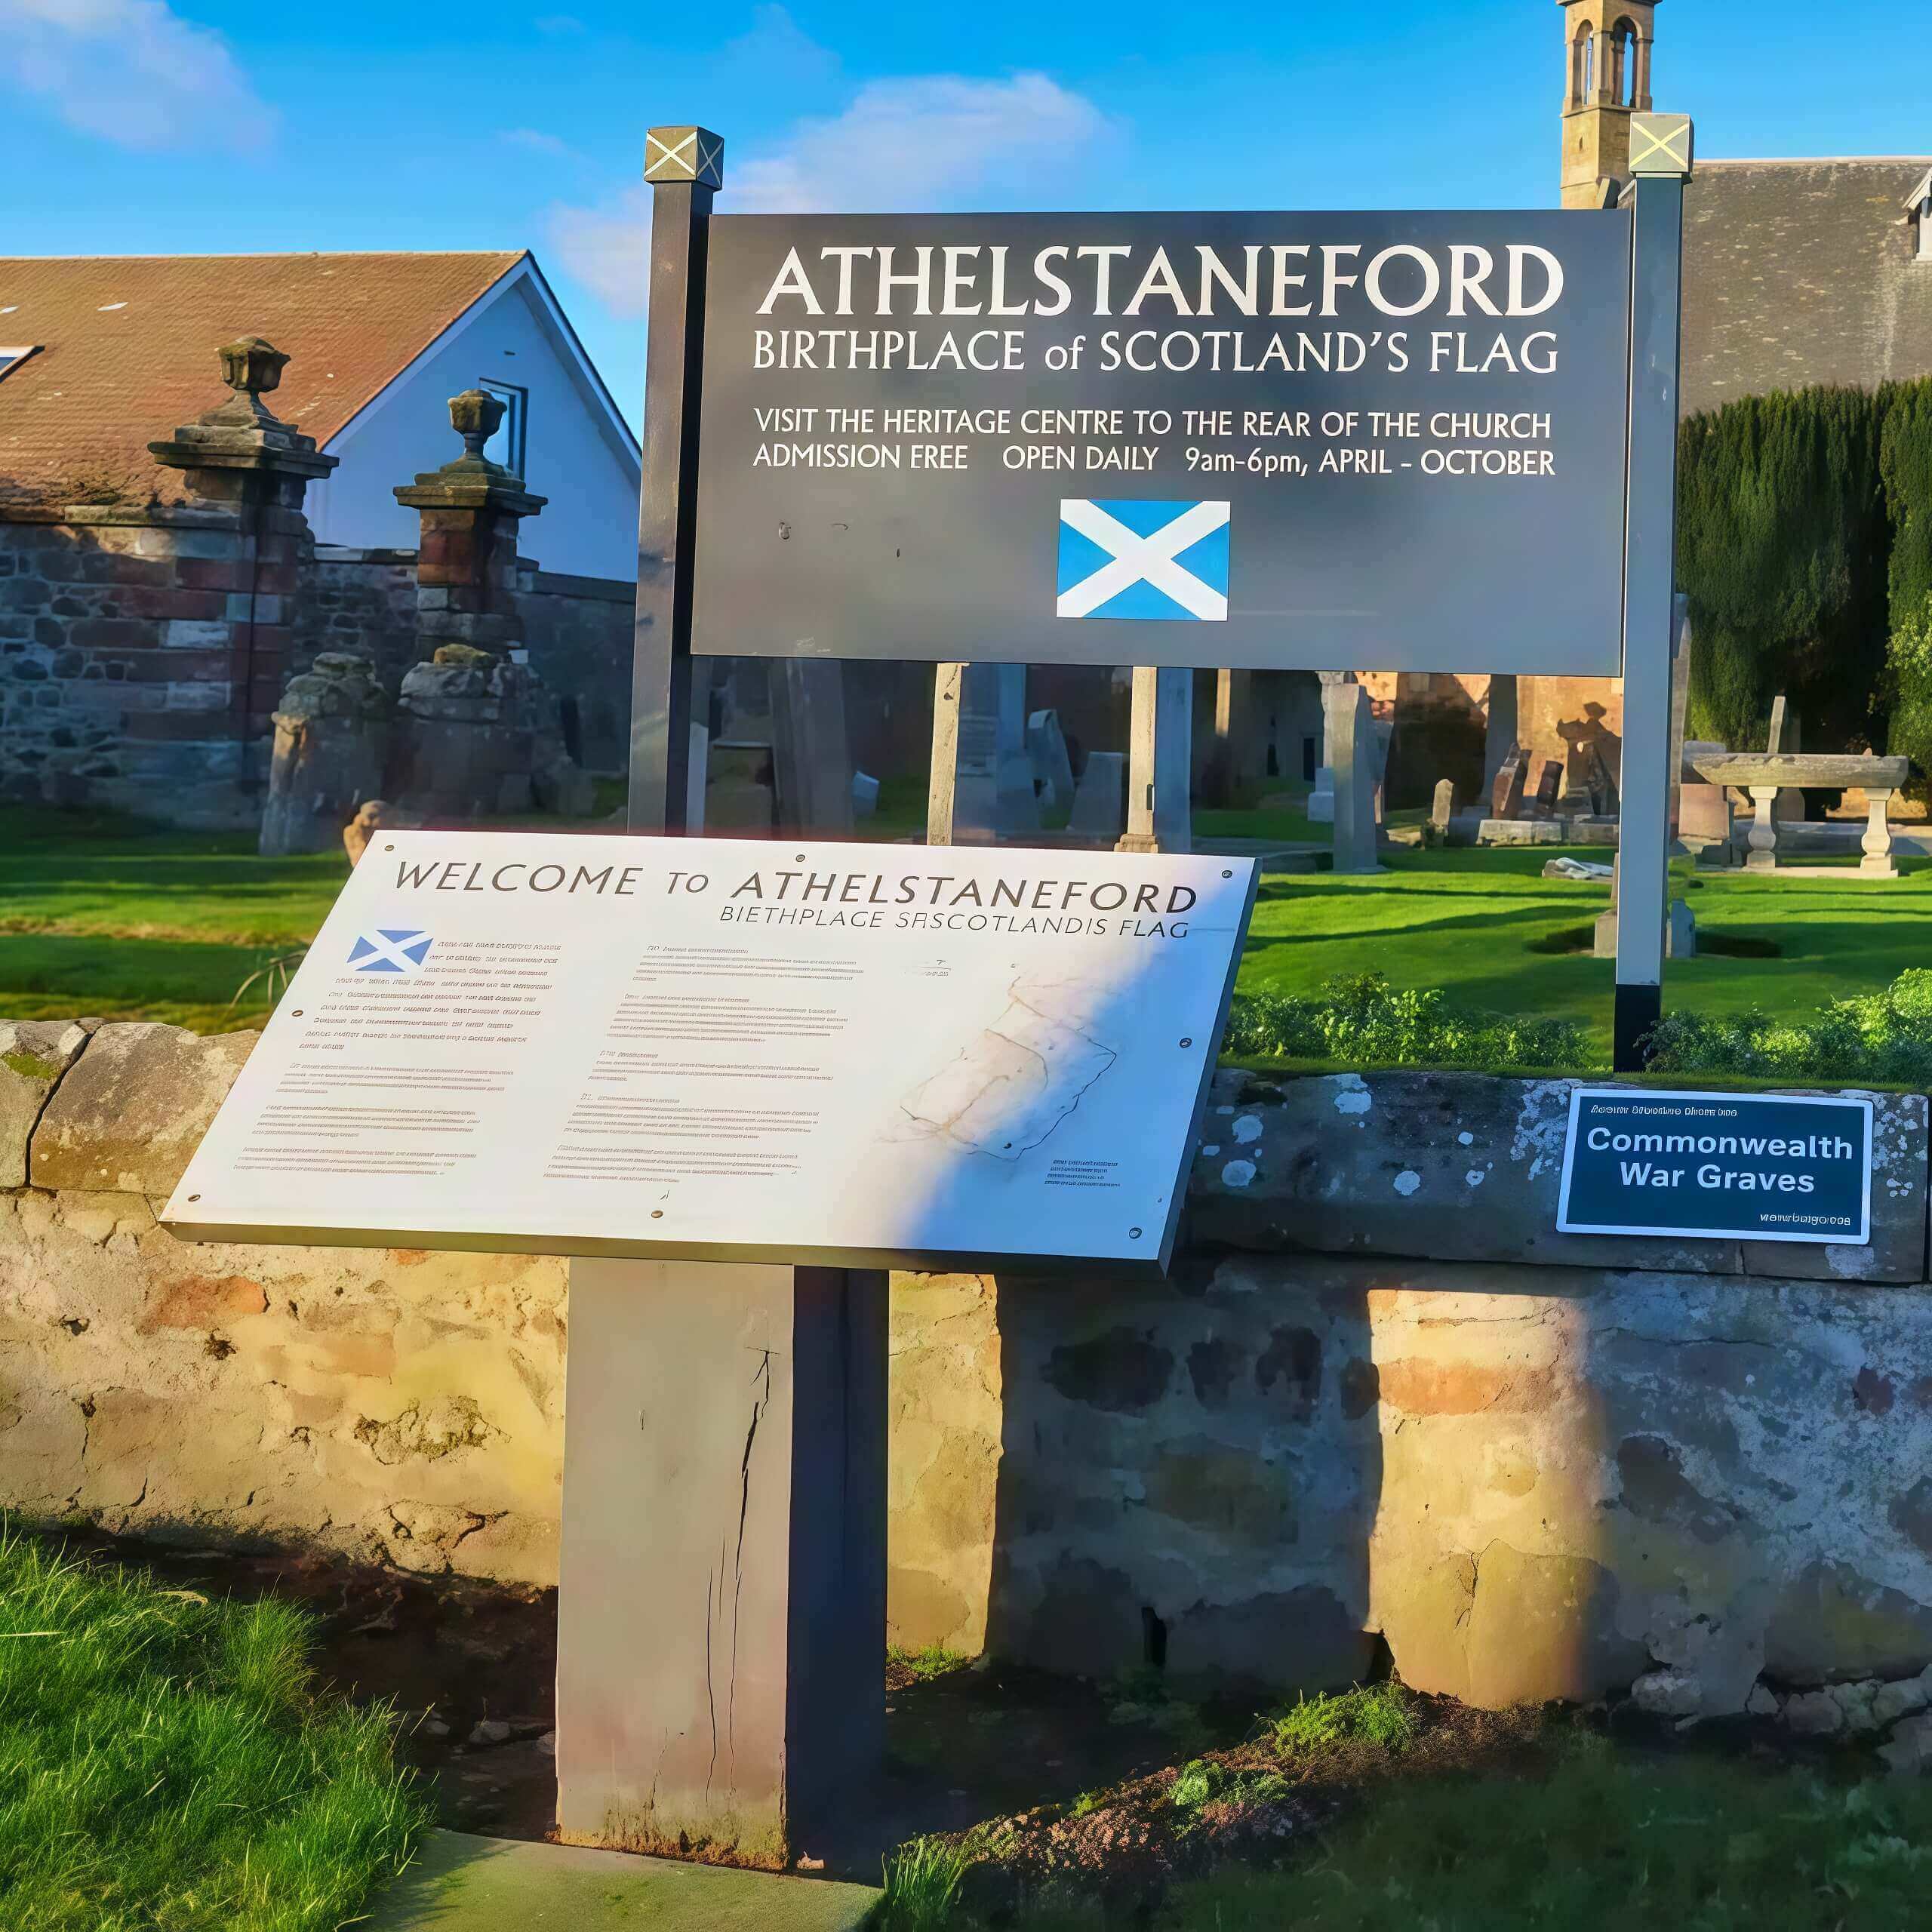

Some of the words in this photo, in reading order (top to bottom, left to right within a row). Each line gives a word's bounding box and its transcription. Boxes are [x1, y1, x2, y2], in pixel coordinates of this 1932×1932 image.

[755, 245, 1564, 317] ATHELSTANEFORD
[752, 330, 1025, 371] BIRTHPLACE
[1044, 335, 1087, 371] of
[1100, 330, 1409, 372] SCOTLAND'S
[1429, 331, 1558, 374] FLAG
[753, 408, 819, 432] VISIT
[825, 408, 875, 433] THE
[884, 409, 1011, 434] HERITAGE
[1020, 409, 1124, 435] CENTRE
[1132, 410, 1172, 435] TO
[1182, 411, 1232, 435] THE
[1243, 411, 1311, 437] REAR
[1321, 411, 1359, 437] OF
[1367, 411, 1420, 437] THE
[1430, 412, 1551, 438] CHURCH
[752, 442, 900, 469] ADMISSION
[910, 445, 968, 469] FREE
[1002, 445, 1075, 470] OPEN
[1085, 445, 1160, 471] DAILY
[1186, 447, 1308, 478] 9am-6pm,
[1318, 448, 1392, 474] APRIL
[1420, 449, 1556, 475] OCTOBER
[395, 860, 644, 896] WELCOME
[667, 872, 709, 895] TO
[730, 871, 1198, 914] ATHELSTANEFORD
[1118, 919, 1189, 939] FLAG
[1586, 1126, 1854, 1161] Commonwealth
[1620, 1161, 1685, 1188] War
[1696, 1163, 1815, 1193] Graves
